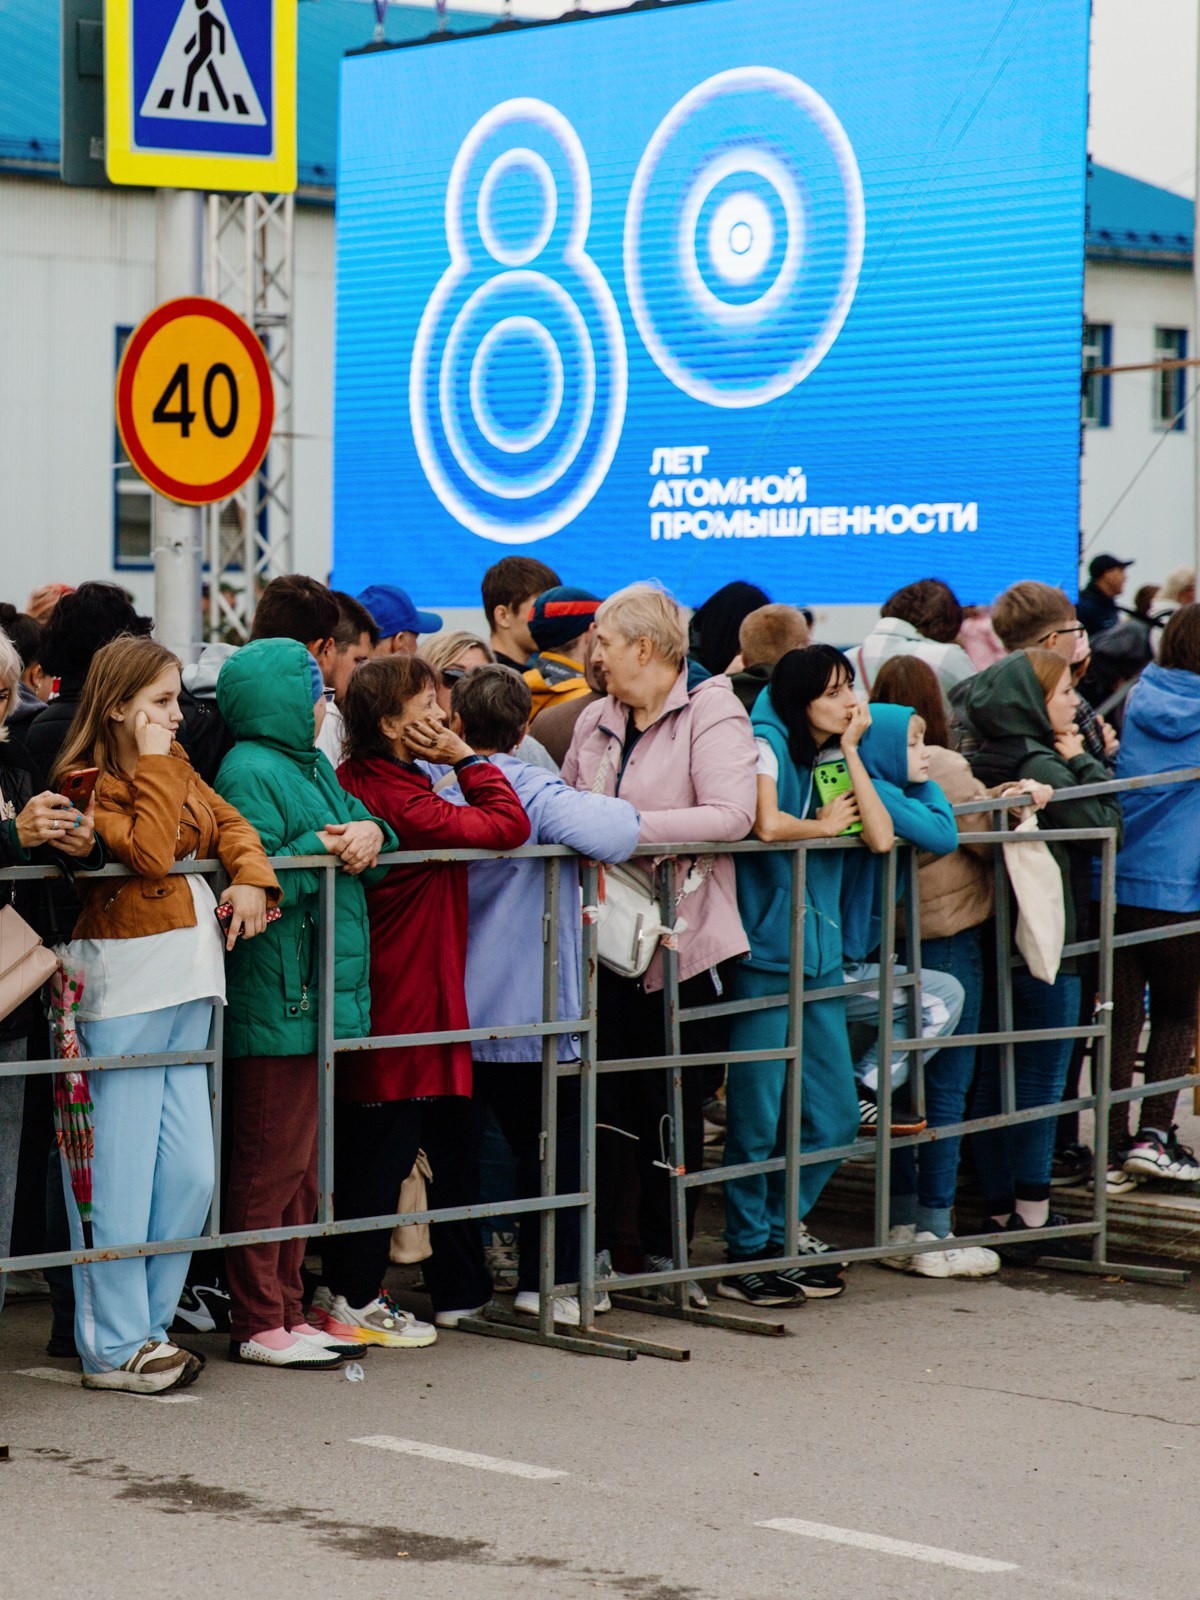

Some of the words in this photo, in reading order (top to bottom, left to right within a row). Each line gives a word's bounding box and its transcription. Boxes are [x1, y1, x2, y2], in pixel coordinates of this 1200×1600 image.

[409, 66, 865, 544] 80
[152, 362, 239, 438] 40
[650, 445, 709, 475] ЛЕТ
[649, 466, 807, 507] АТОМНОЙ
[650, 501, 978, 540] ПРОМЫШЛЕННОСТИ
